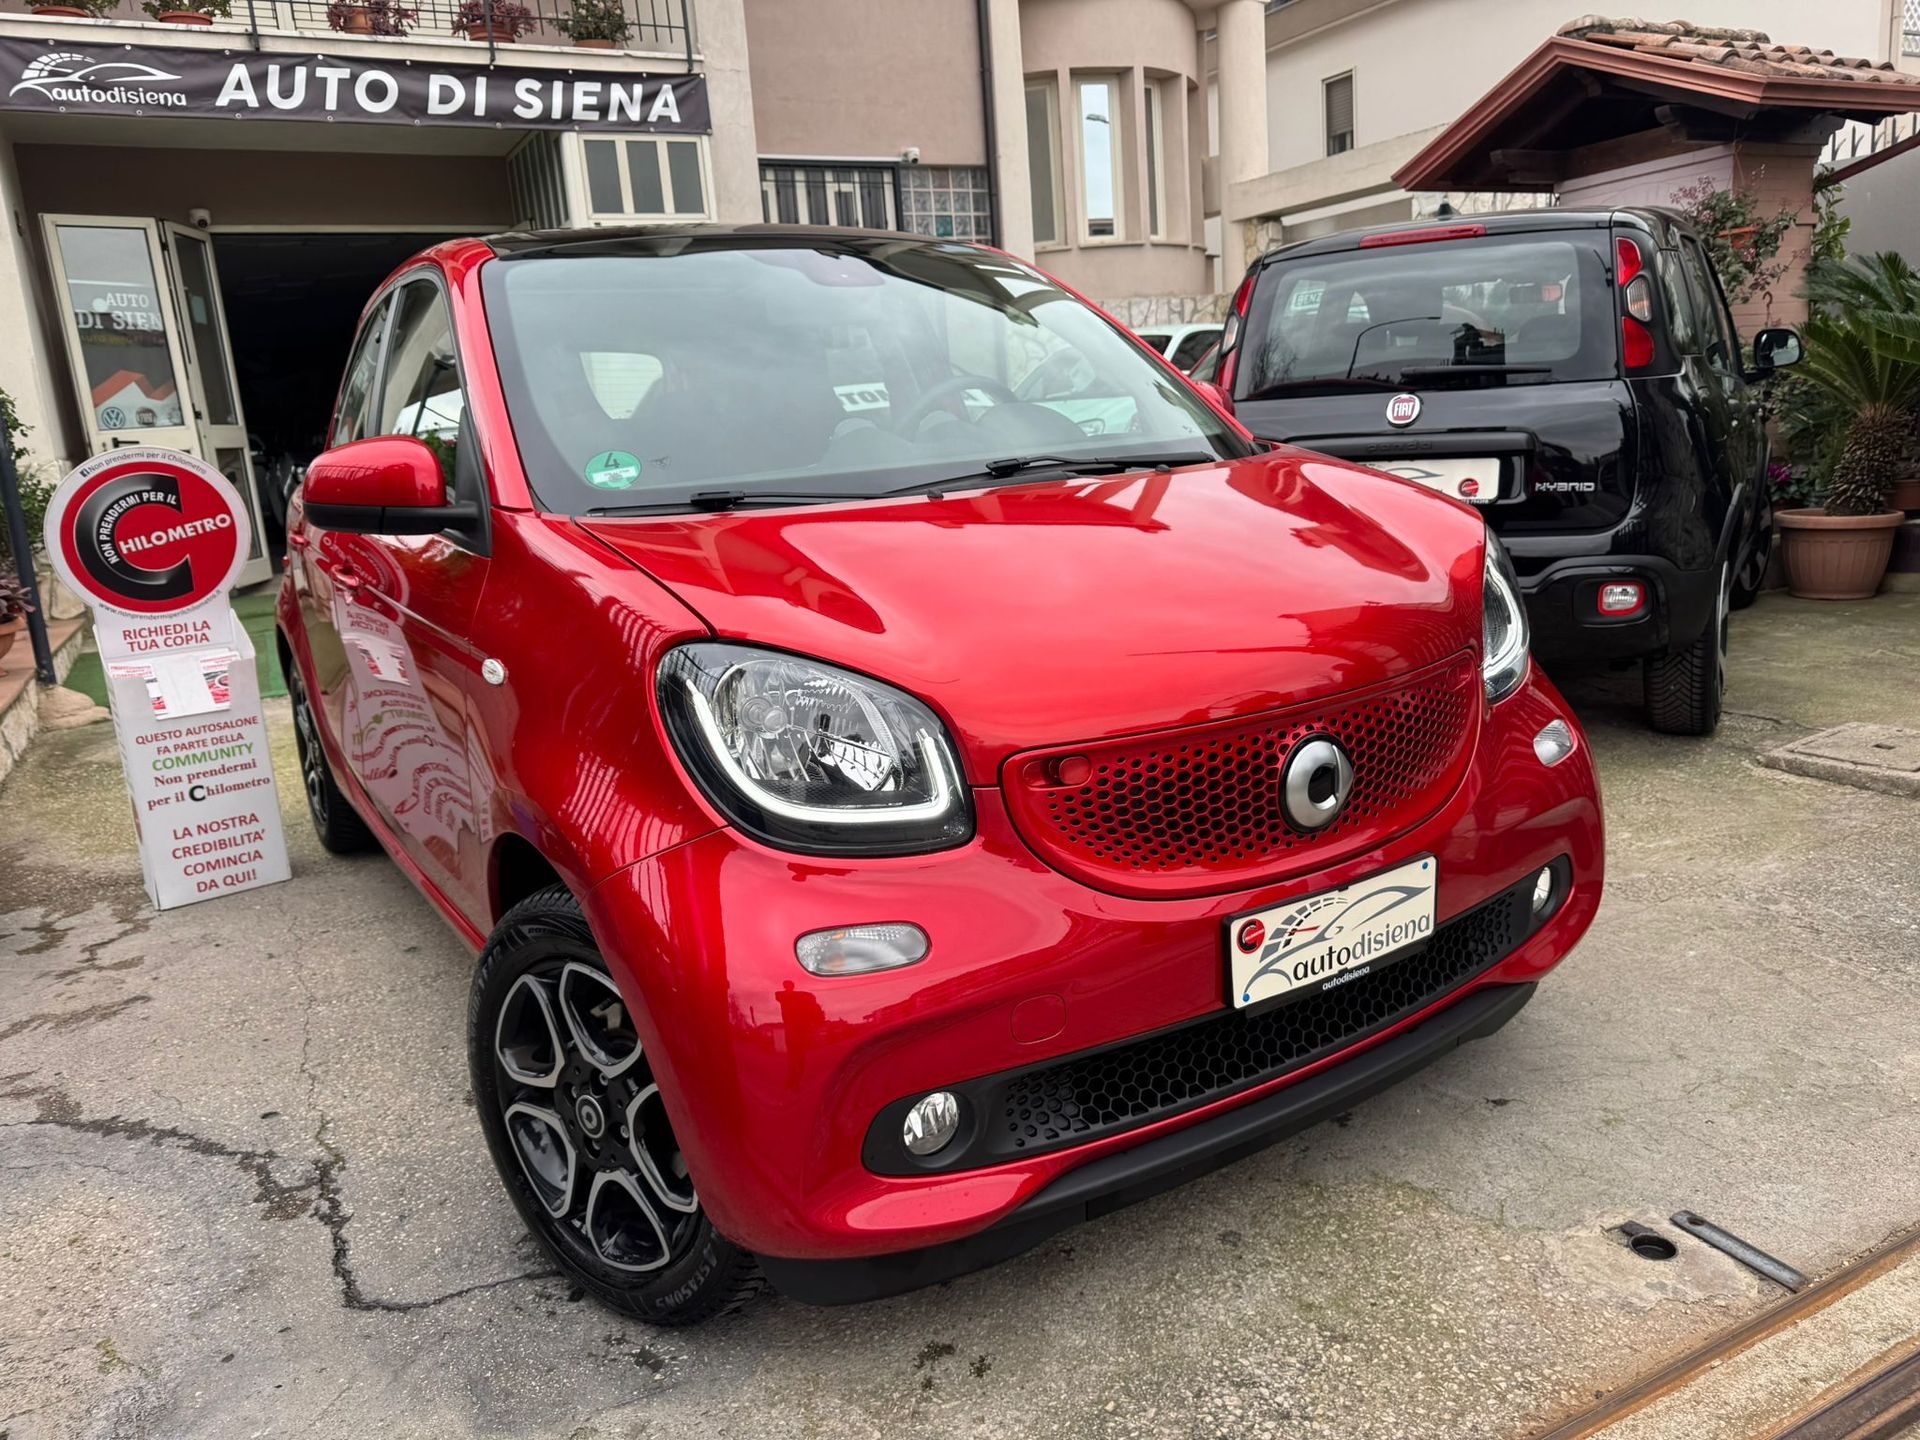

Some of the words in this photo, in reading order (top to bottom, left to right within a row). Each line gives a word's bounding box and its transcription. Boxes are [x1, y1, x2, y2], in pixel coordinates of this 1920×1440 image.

[52, 84, 187, 107] autodisiena
[215, 63, 399, 113] AUTO
[427, 74, 486, 117] DI
[513, 78, 681, 123] SIENA
[105, 292, 149, 308] AUTO
[77, 309, 104, 329] DI
[1394, 401, 1416, 417] FIAT
[88, 461, 105, 474] Non
[104, 452, 145, 465] prendermi
[146, 452, 160, 460] per
[167, 453, 208, 475] Chilometro
[604, 452, 621, 468] 4
[142, 491, 165, 502] PER
[166, 492, 178, 505] IL
[1535, 482, 1595, 492] HYBRID
[99, 493, 141, 541] PRENDERMI
[104, 542, 120, 565] NON
[122, 620, 189, 641] RICHIEDI
[192, 619, 211, 632] LA
[126, 639, 159, 652] TUA
[164, 633, 210, 649] COPIA
[135, 729, 183, 746] QUESTO
[185, 715, 259, 738] AUTOSALONE
[157, 744, 172, 756] FA
[173, 737, 209, 753] PARTE
[210, 731, 245, 748] DELLA
[152, 742, 254, 771] COMMUNITY
[154, 773, 183, 787] Non
[186, 758, 257, 785] prendermi
[147, 793, 172, 811] per
[175, 790, 185, 804] il
[188, 775, 271, 802] Chilometro
[173, 826, 193, 841] LA
[197, 813, 259, 836] NOSTRA
[172, 828, 266, 859] CREDIBILITA'
[184, 850, 263, 876] COMINCIA
[197, 878, 220, 893] DA
[222, 869, 257, 888] QUI!
[1293, 912, 1431, 981] autodisiena
[1322, 966, 1370, 991] autodisiena
